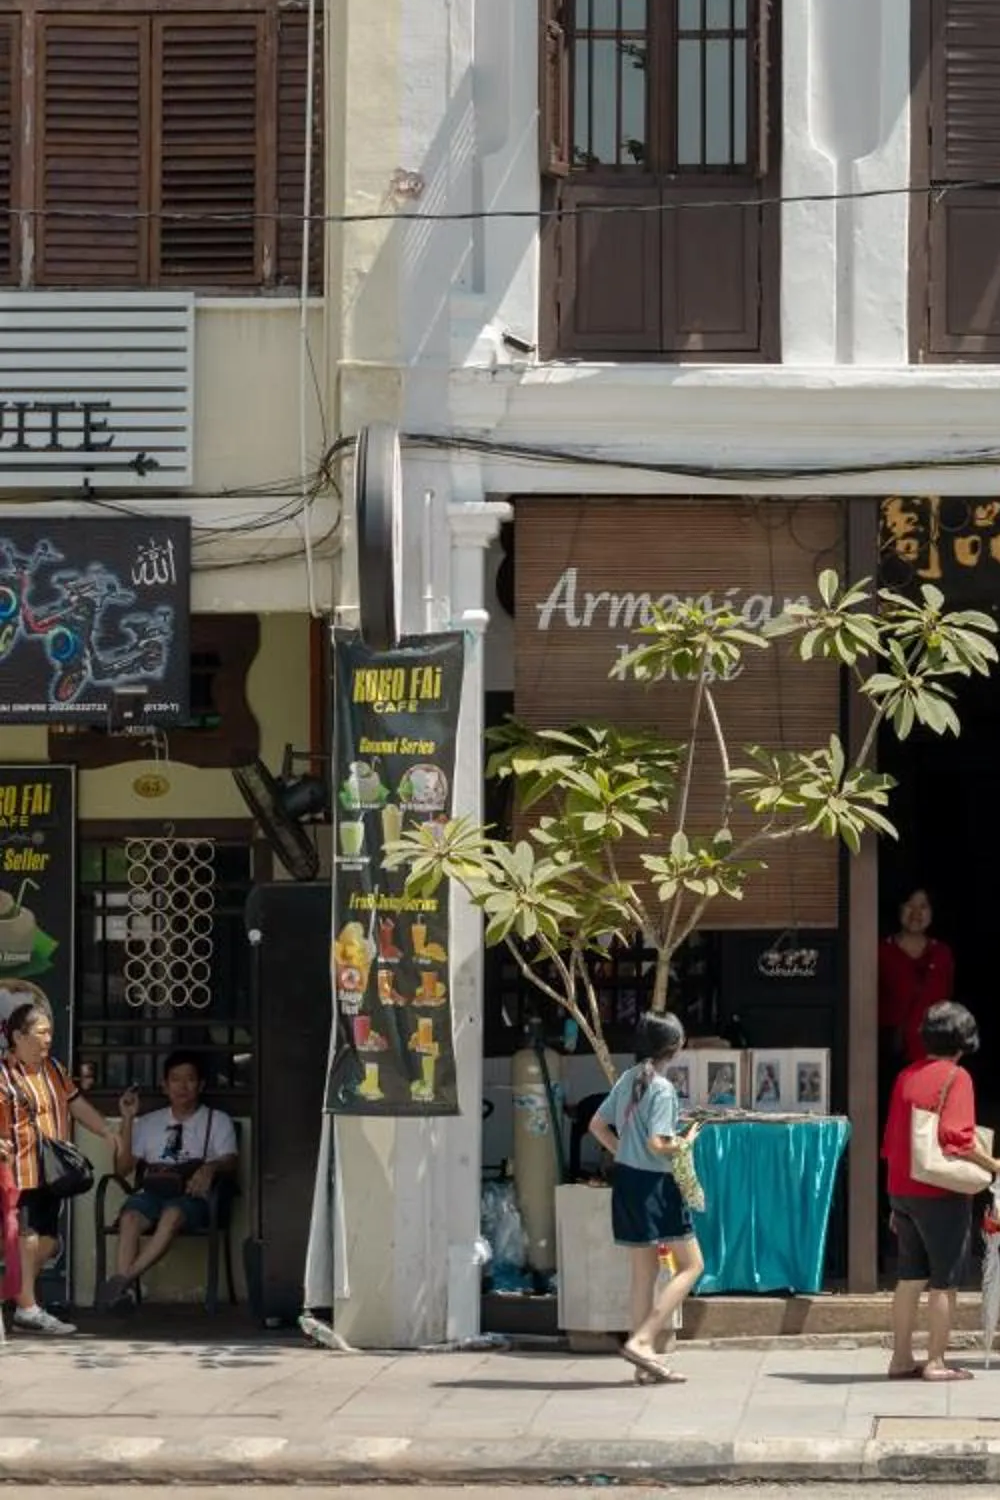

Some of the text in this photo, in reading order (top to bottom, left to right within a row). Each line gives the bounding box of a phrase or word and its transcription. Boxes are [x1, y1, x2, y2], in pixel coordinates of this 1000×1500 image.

[0, 400, 115, 452] ITE
[536, 567, 812, 631] Armena
[0, 815, 29, 828] AFE
[4, 848, 50, 871] Seller
